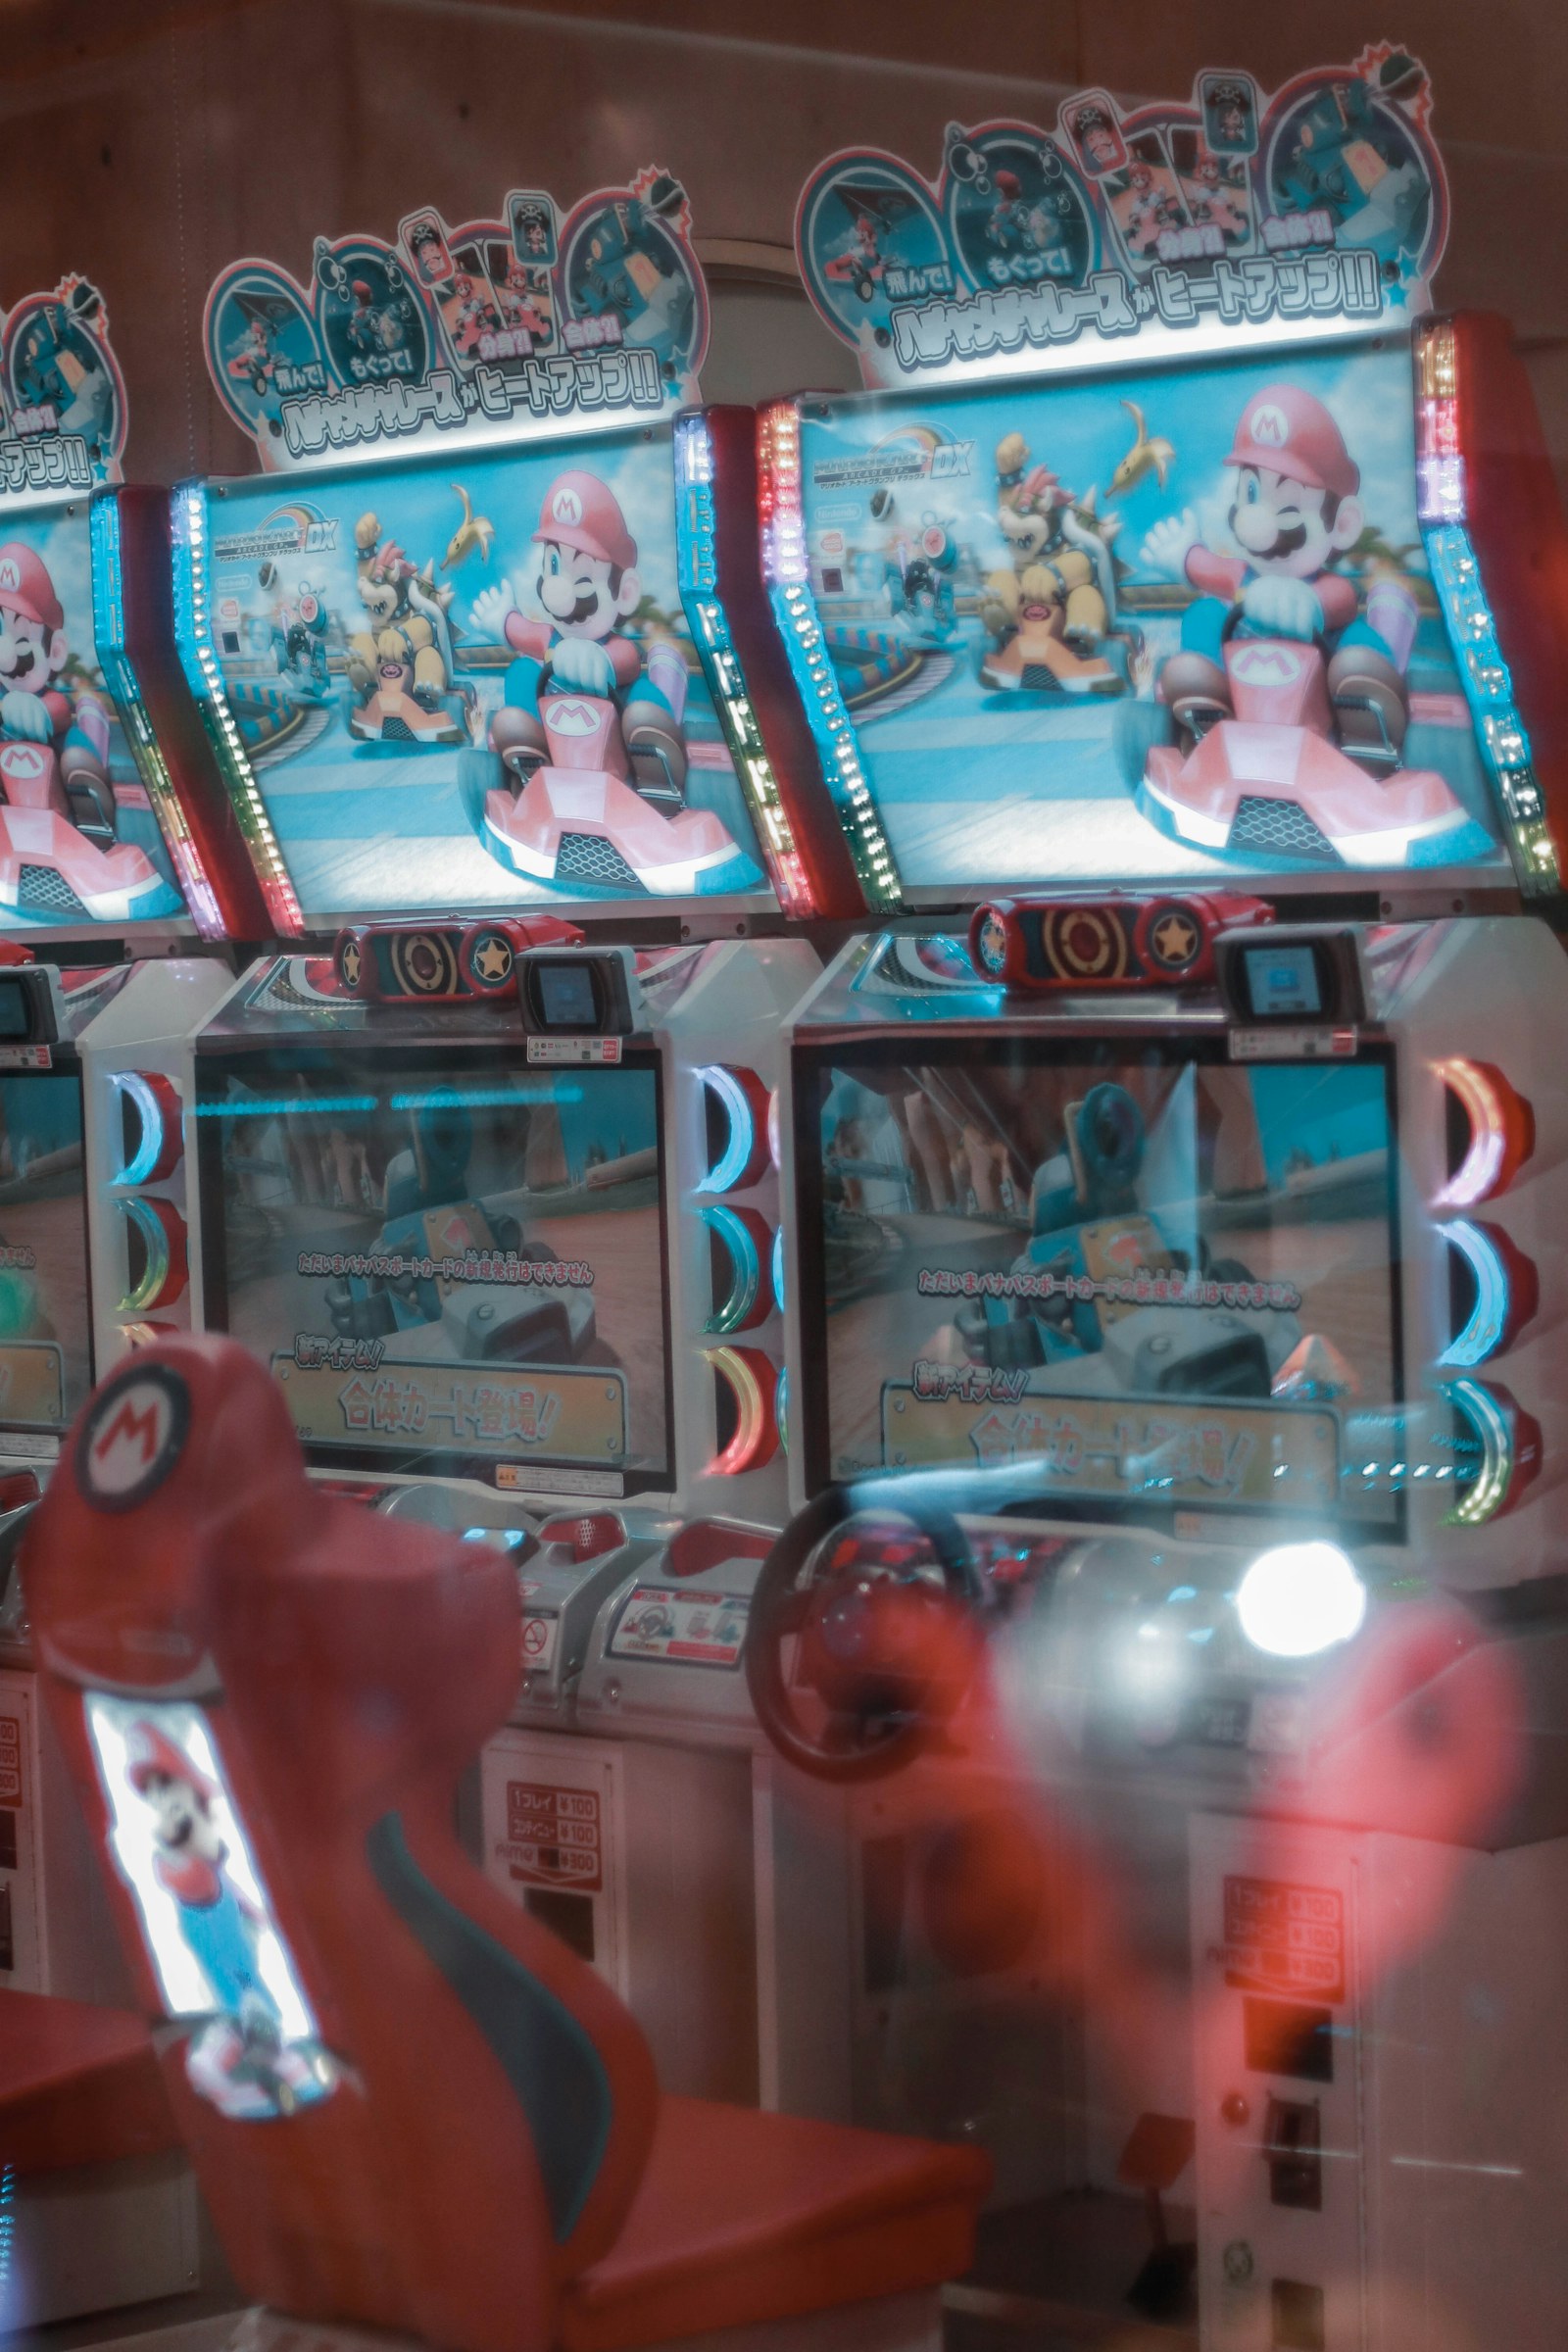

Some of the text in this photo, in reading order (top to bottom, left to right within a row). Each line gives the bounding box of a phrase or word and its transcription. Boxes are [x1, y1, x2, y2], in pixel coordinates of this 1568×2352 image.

[987, 247, 1073, 281] もぐって!
[885, 264, 954, 294] 飛んで!
[274, 363, 326, 391] 飛んで!
[349, 348, 415, 378] もぐって!
[1254, 413, 1281, 441] M
[930, 440, 975, 479] DX
[555, 495, 576, 521] M
[817, 508, 858, 518] Nintendo
[305, 518, 340, 554] DX
[1237, 649, 1295, 677] M
[550, 704, 597, 727] M
[4, 749, 40, 771] M
[94, 1399, 159, 1465] M
[514, 1789, 552, 1811] 1プレイ
